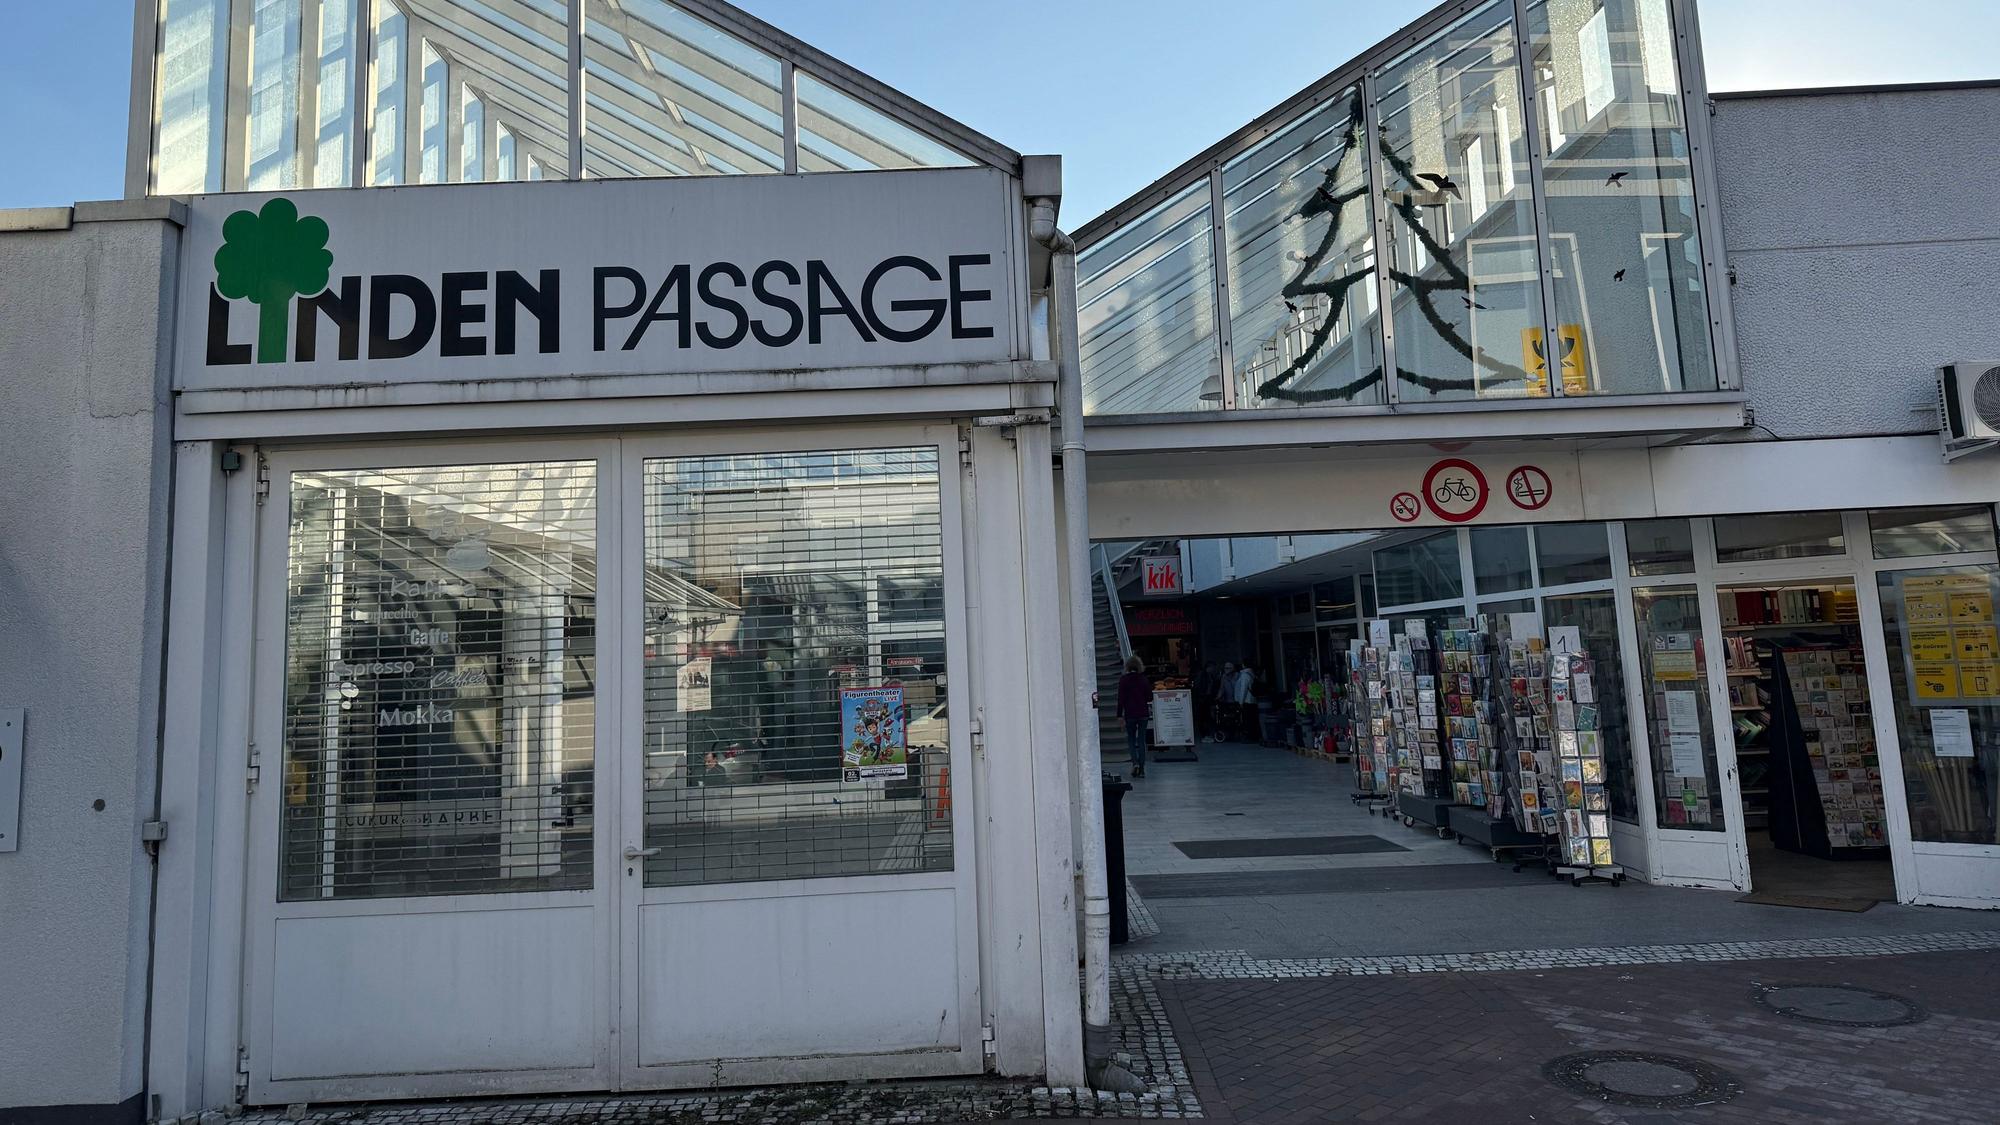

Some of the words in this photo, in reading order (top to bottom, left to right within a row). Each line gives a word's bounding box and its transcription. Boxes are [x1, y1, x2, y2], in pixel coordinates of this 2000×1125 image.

[206, 266, 560, 366] LINDEN
[593, 253, 994, 351] PASSAGE
[1147, 563, 1176, 589] kik
[391, 577, 477, 597] Kafe
[351, 608, 419, 623] Cppuccino
[333, 659, 415, 679] spresso
[844, 689, 900, 699] Figurentheater
[380, 703, 454, 728] Mokka
